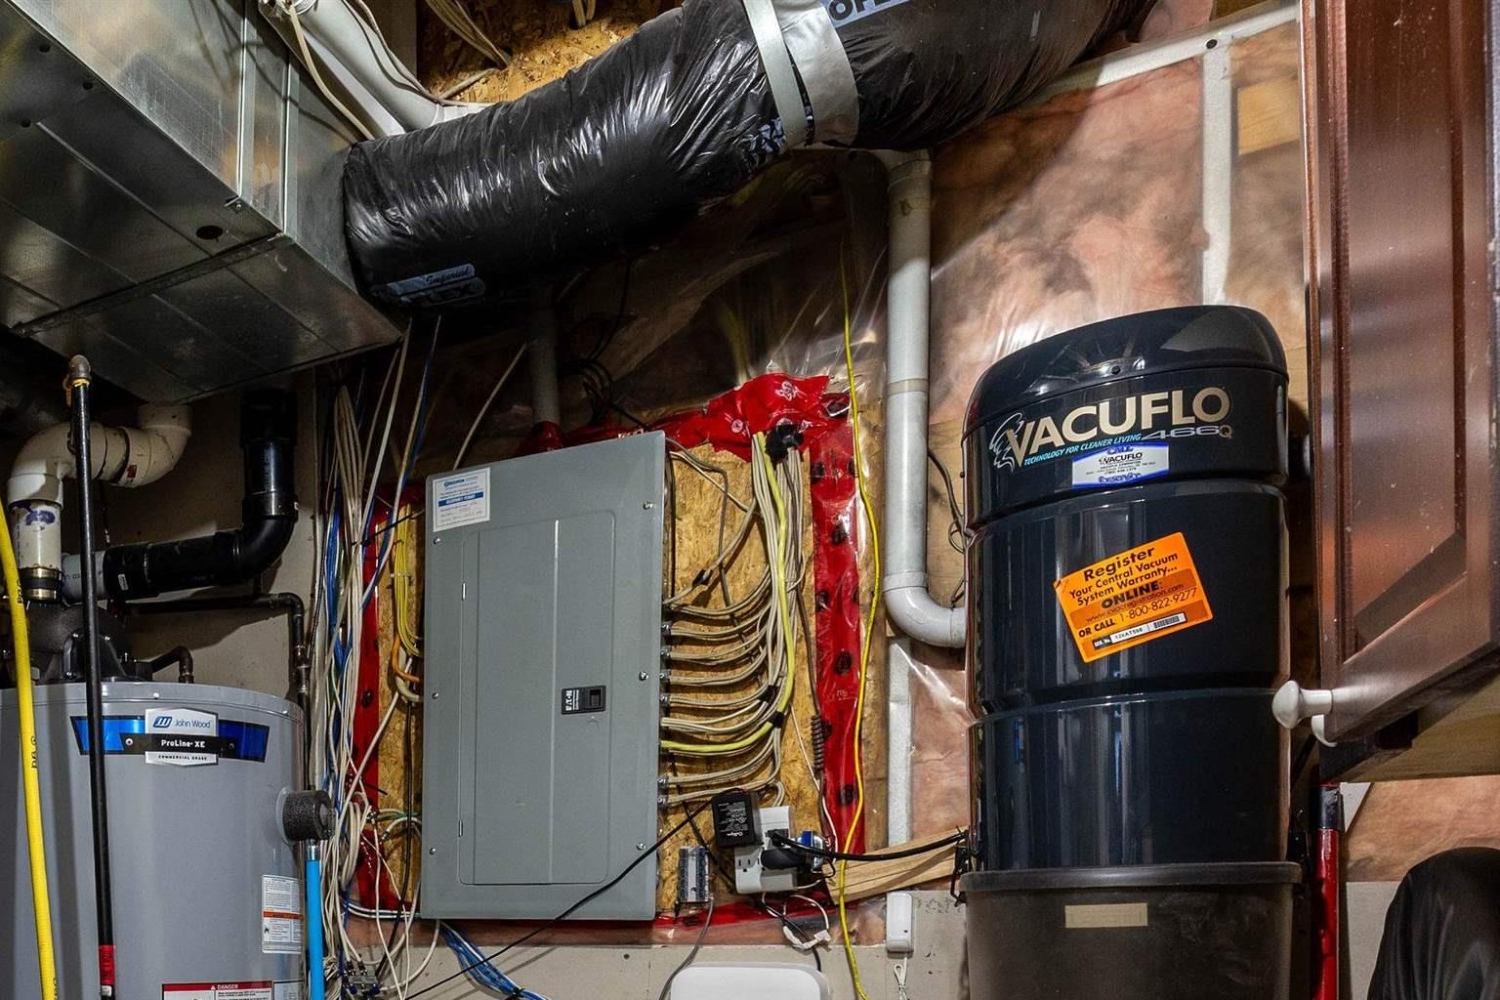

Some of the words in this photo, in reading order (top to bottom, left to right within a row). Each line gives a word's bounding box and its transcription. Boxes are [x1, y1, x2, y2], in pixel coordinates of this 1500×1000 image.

[1005, 386, 1230, 468] VACUFLO
[1024, 447, 1065, 467] TECHNOLOGY
[1065, 444, 1080, 456] FOR
[1080, 438, 1113, 452] CLEANER
[1113, 432, 1142, 445] LIVING
[1070, 585, 1093, 599] Your
[1096, 567, 1133, 588] Central
[1135, 553, 1178, 572] Vacuum
[1083, 547, 1156, 582] Register
[1077, 586, 1114, 606] System
[1078, 627, 1092, 638] OR
[1094, 618, 1116, 632] CALL
[1120, 587, 1197, 622] 1-800-822-9277
[175, 719, 191, 728] John
[191, 720, 210, 728] Wood
[194, 740, 206, 748] XE
